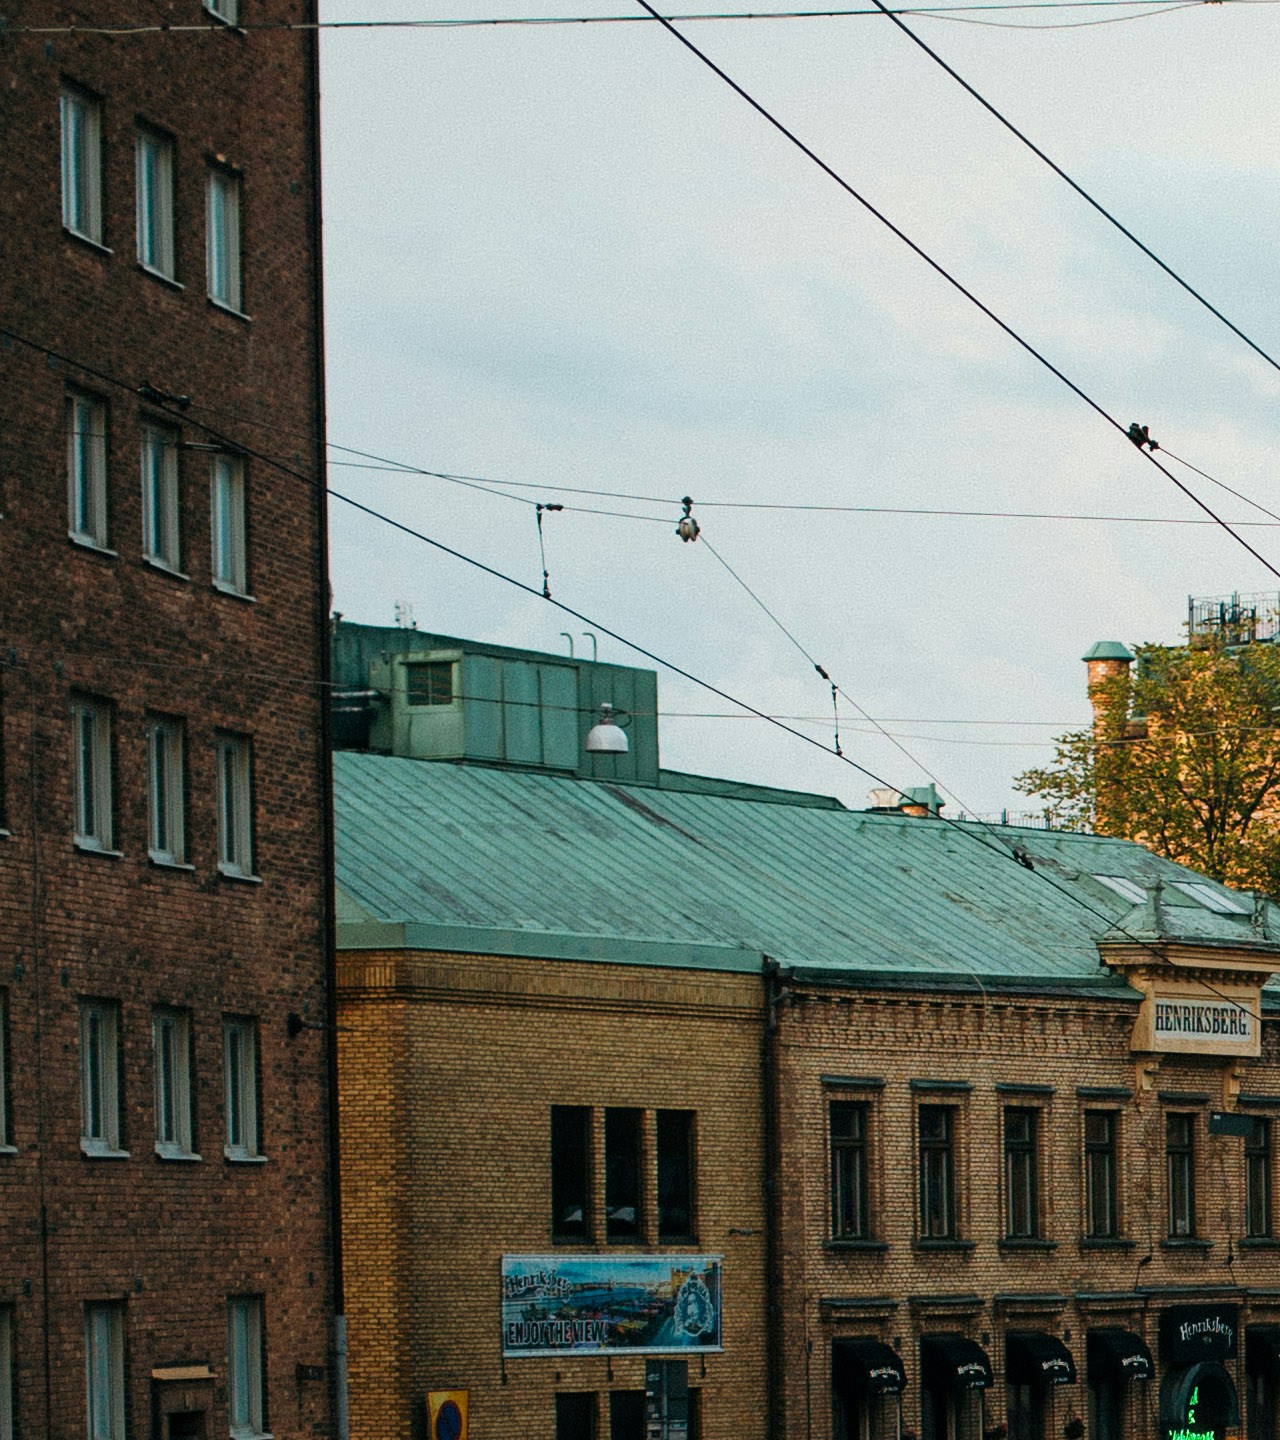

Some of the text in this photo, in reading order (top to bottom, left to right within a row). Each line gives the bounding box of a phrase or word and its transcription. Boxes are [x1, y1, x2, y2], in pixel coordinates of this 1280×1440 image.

[1156, 1003, 1251, 1036] HENRIKSBERG.
[508, 1322, 545, 1346] ENJOY
[546, 1321, 571, 1344] THE
[1180, 1316, 1233, 1348] Henriksberg
